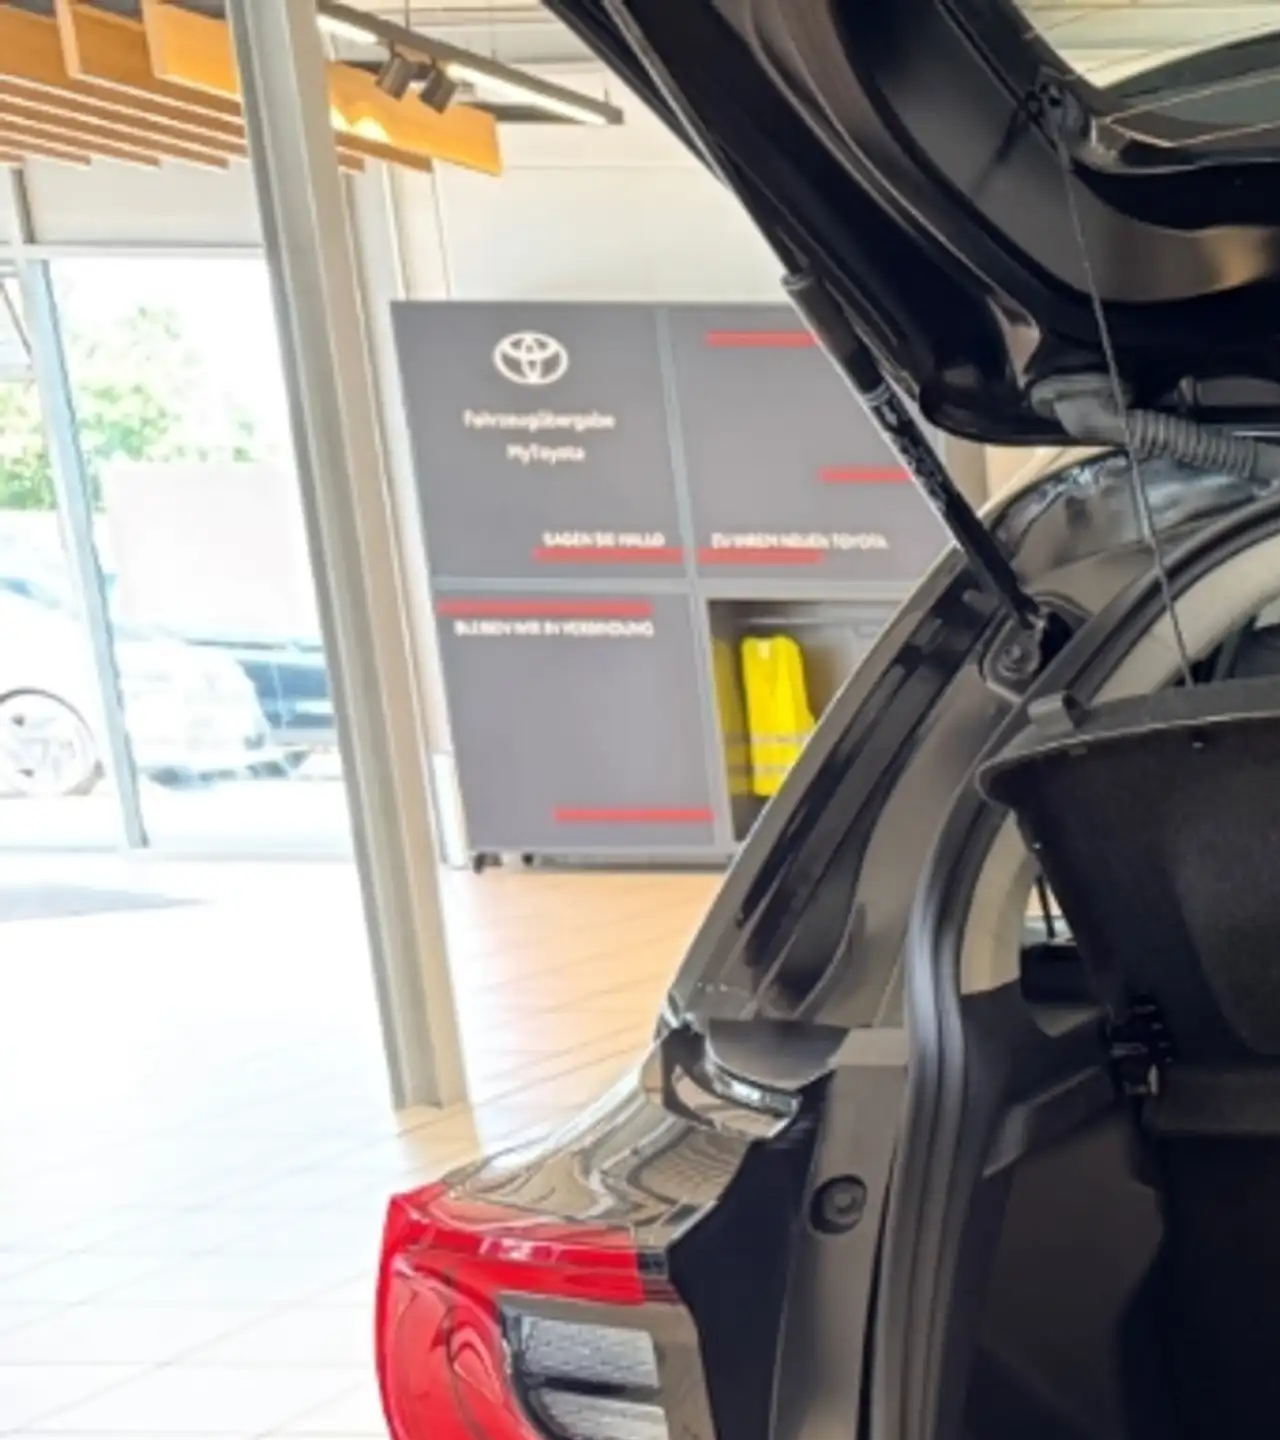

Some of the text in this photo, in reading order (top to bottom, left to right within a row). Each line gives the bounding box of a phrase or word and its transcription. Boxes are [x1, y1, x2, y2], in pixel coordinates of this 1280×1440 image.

[463, 409, 616, 432] Fahrzeugübergabe
[506, 443, 586, 466] MyToyota
[541, 530, 594, 547] SAGEN
[618, 531, 666, 548] HALLO
[831, 532, 890, 549] TOYOTA
